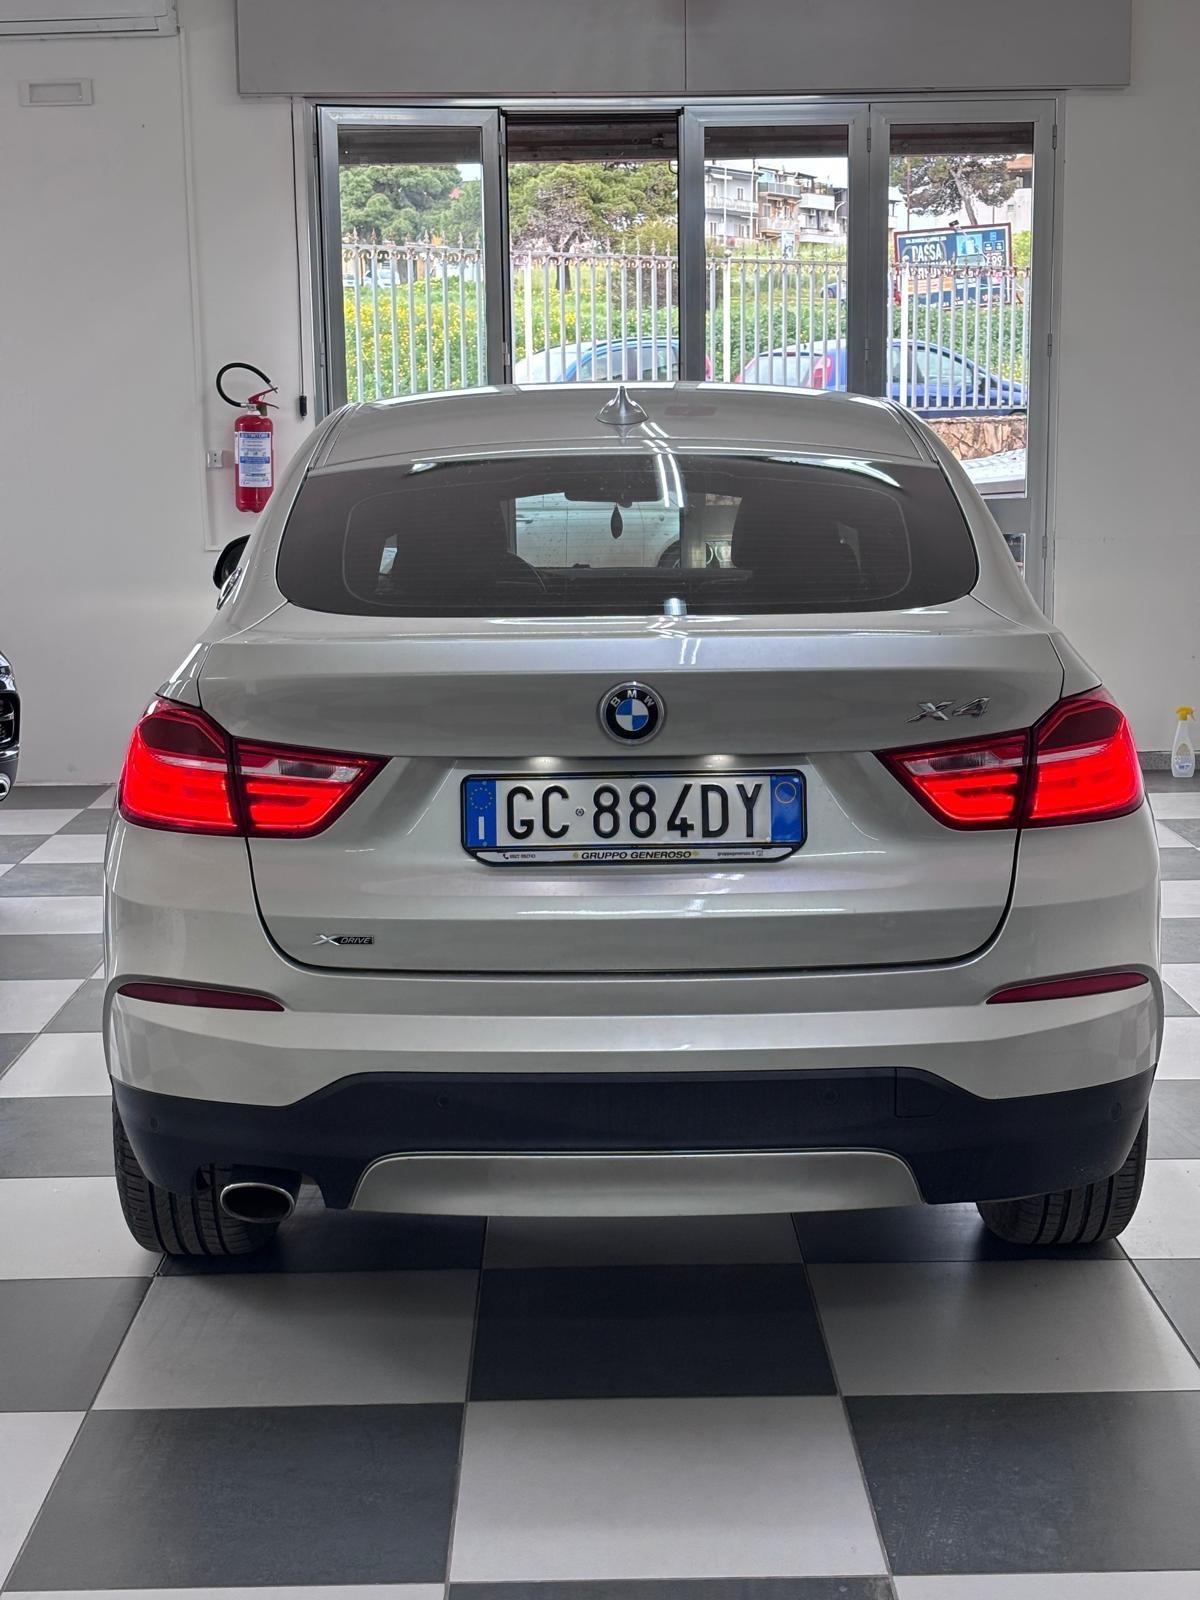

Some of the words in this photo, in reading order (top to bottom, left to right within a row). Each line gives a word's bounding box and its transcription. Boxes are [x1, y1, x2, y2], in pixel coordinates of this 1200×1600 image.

[610, 690, 655, 708] BMW
[904, 696, 991, 723] X4
[506, 784, 570, 839] GC
[592, 783, 763, 839] 884DY
[581, 851, 627, 860] GRUPPO
[630, 850, 692, 860] GENEROSO
